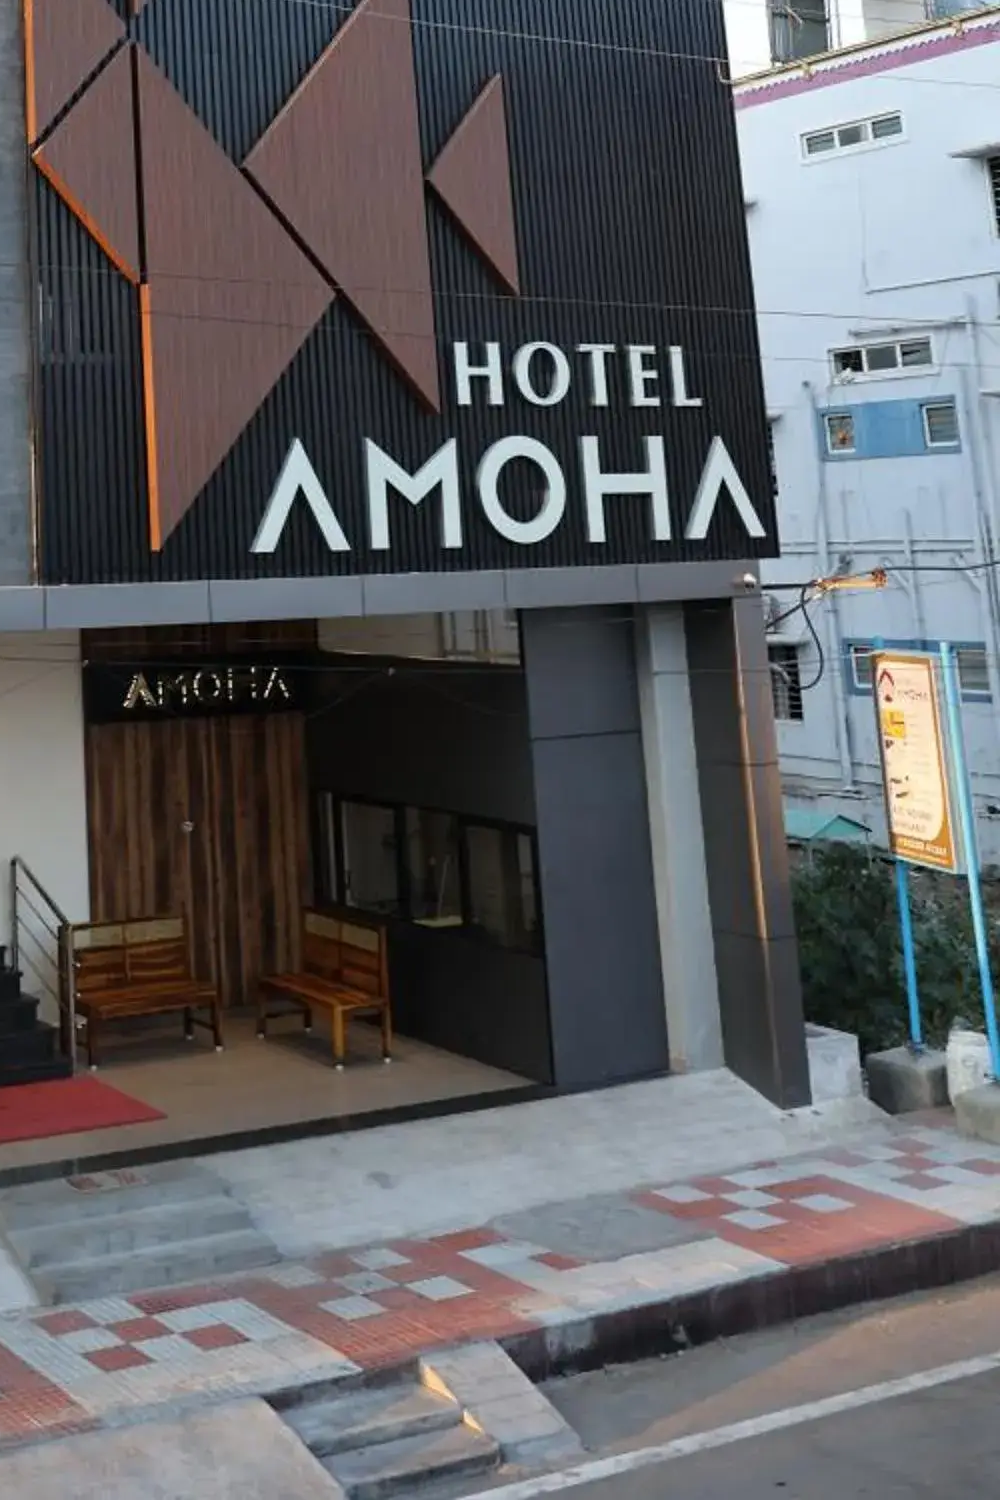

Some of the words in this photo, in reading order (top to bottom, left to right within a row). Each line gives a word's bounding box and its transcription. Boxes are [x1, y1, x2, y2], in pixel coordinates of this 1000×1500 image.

[453, 340, 702, 407] HOTEL
[249, 435, 767, 553] AMOHA
[122, 666, 291, 709] AMOHA
